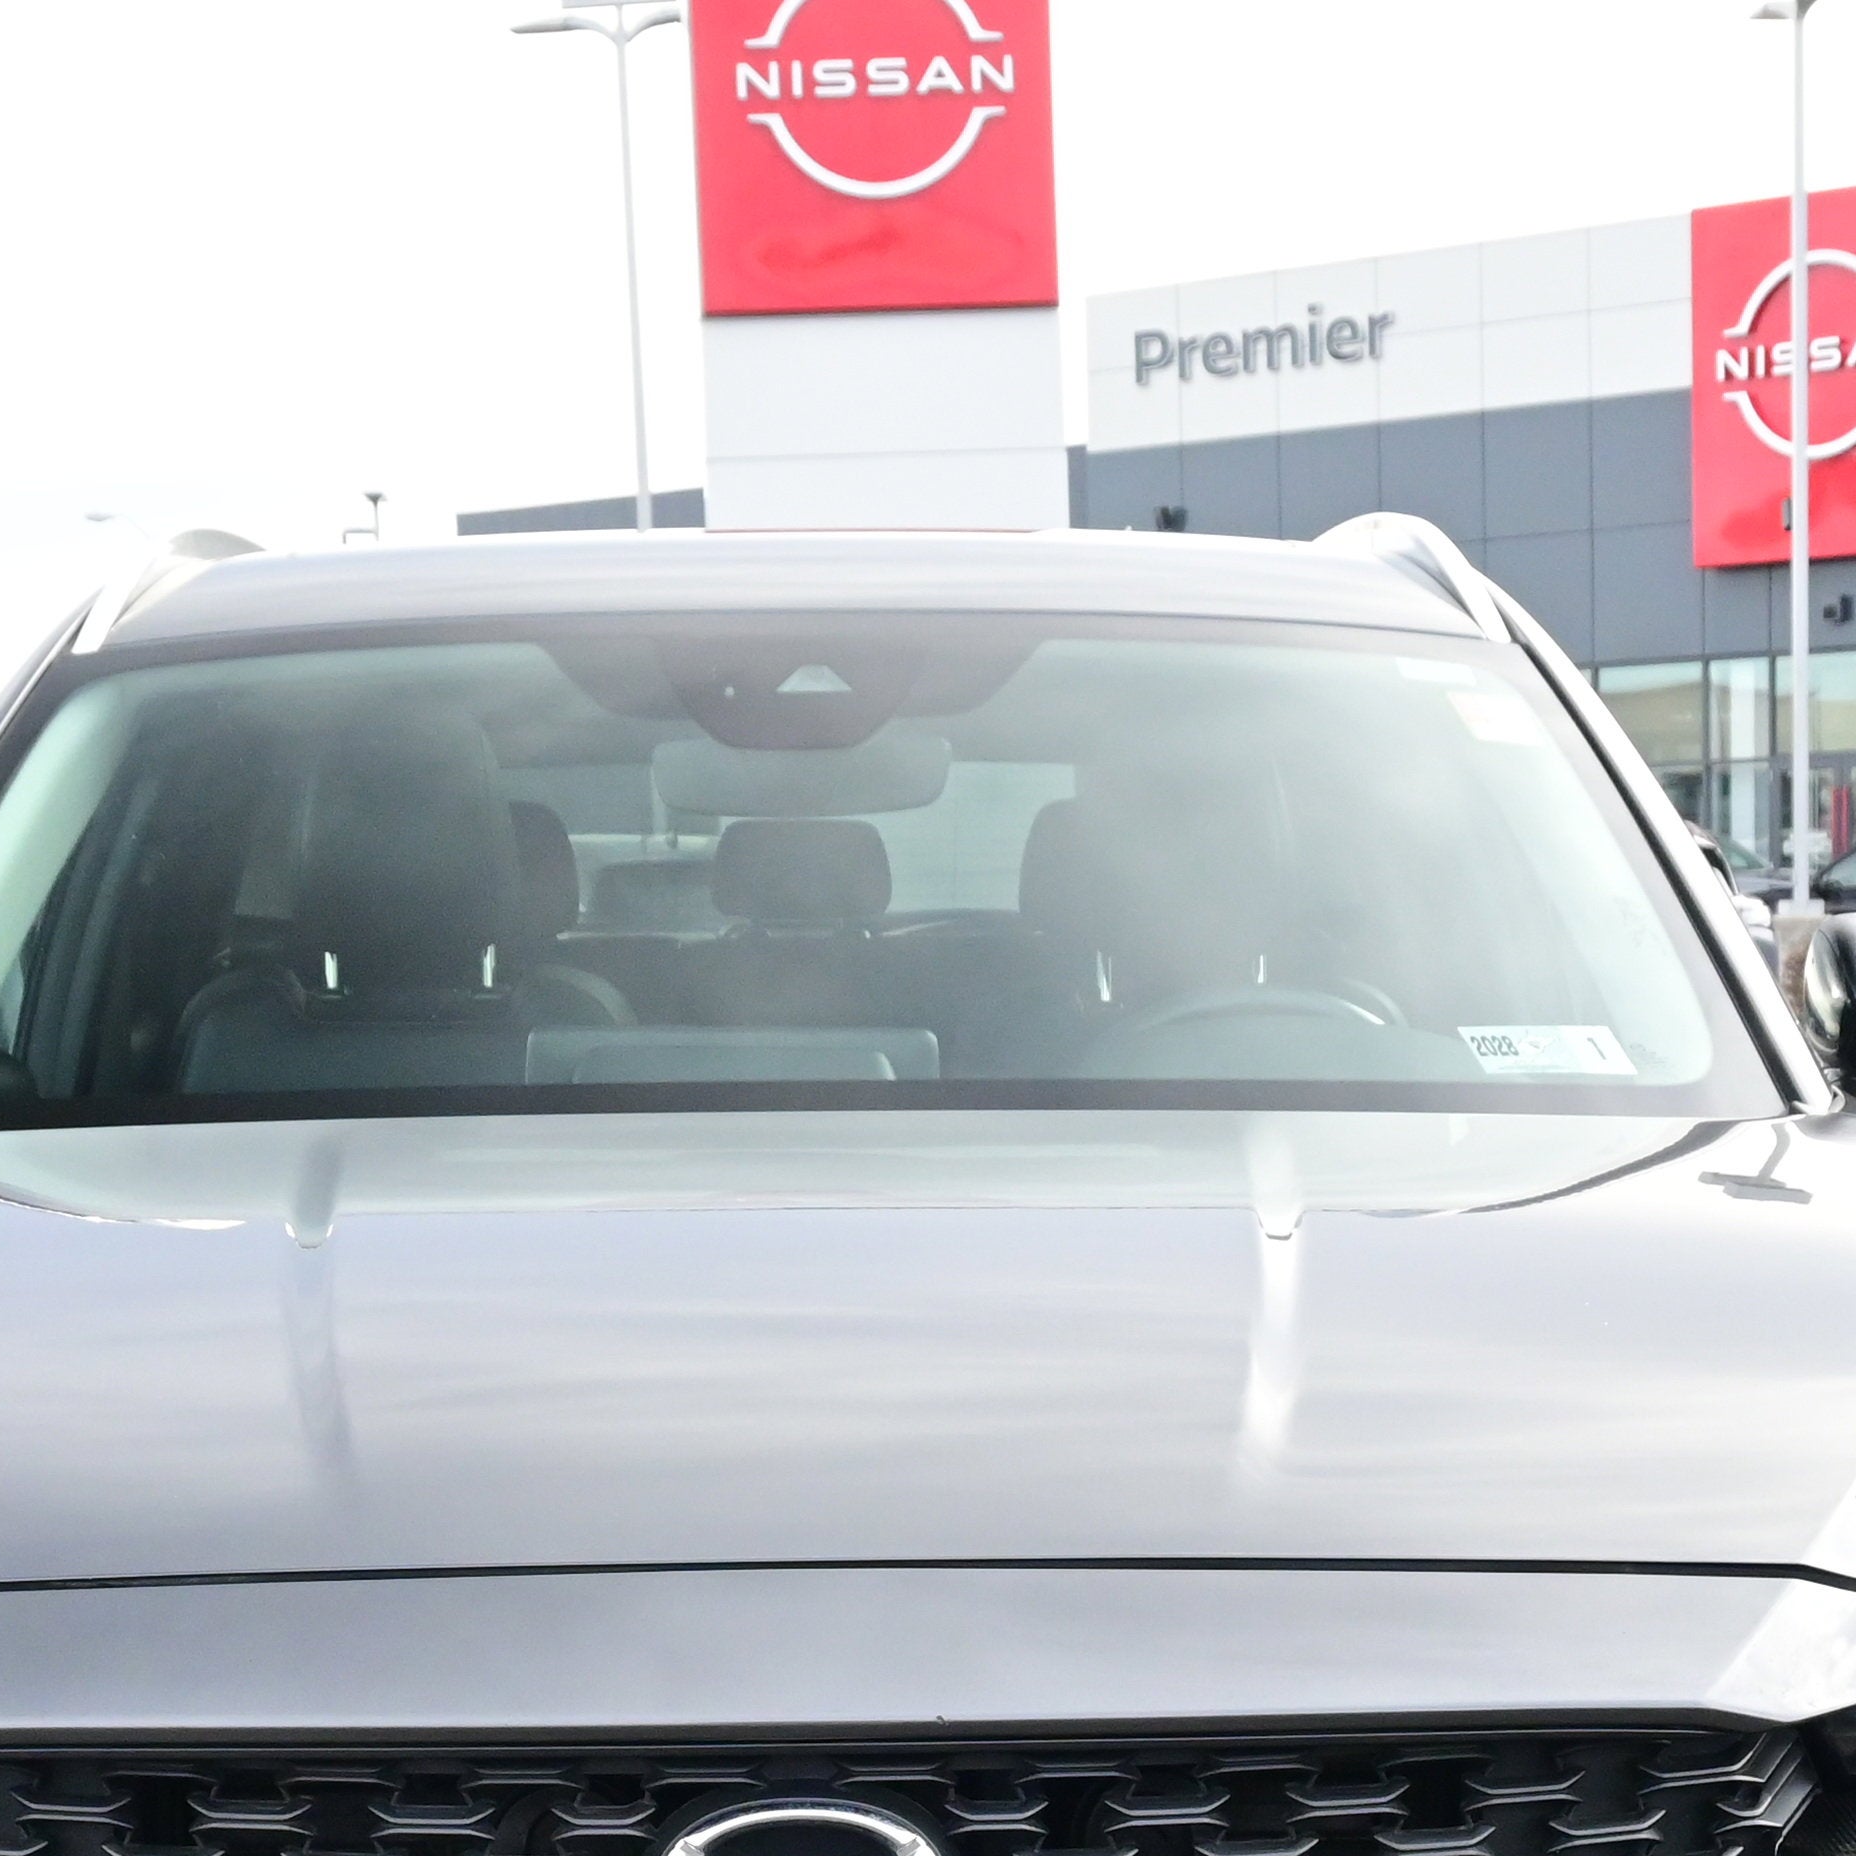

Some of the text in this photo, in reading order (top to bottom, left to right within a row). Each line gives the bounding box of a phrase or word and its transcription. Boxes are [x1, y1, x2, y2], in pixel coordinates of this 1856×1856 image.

[736, 54, 1015, 101] NISSAN
[1134, 302, 1395, 386] Premier
[1470, 1035, 1520, 1057] 2028
[1586, 1037, 1607, 1061] 1
